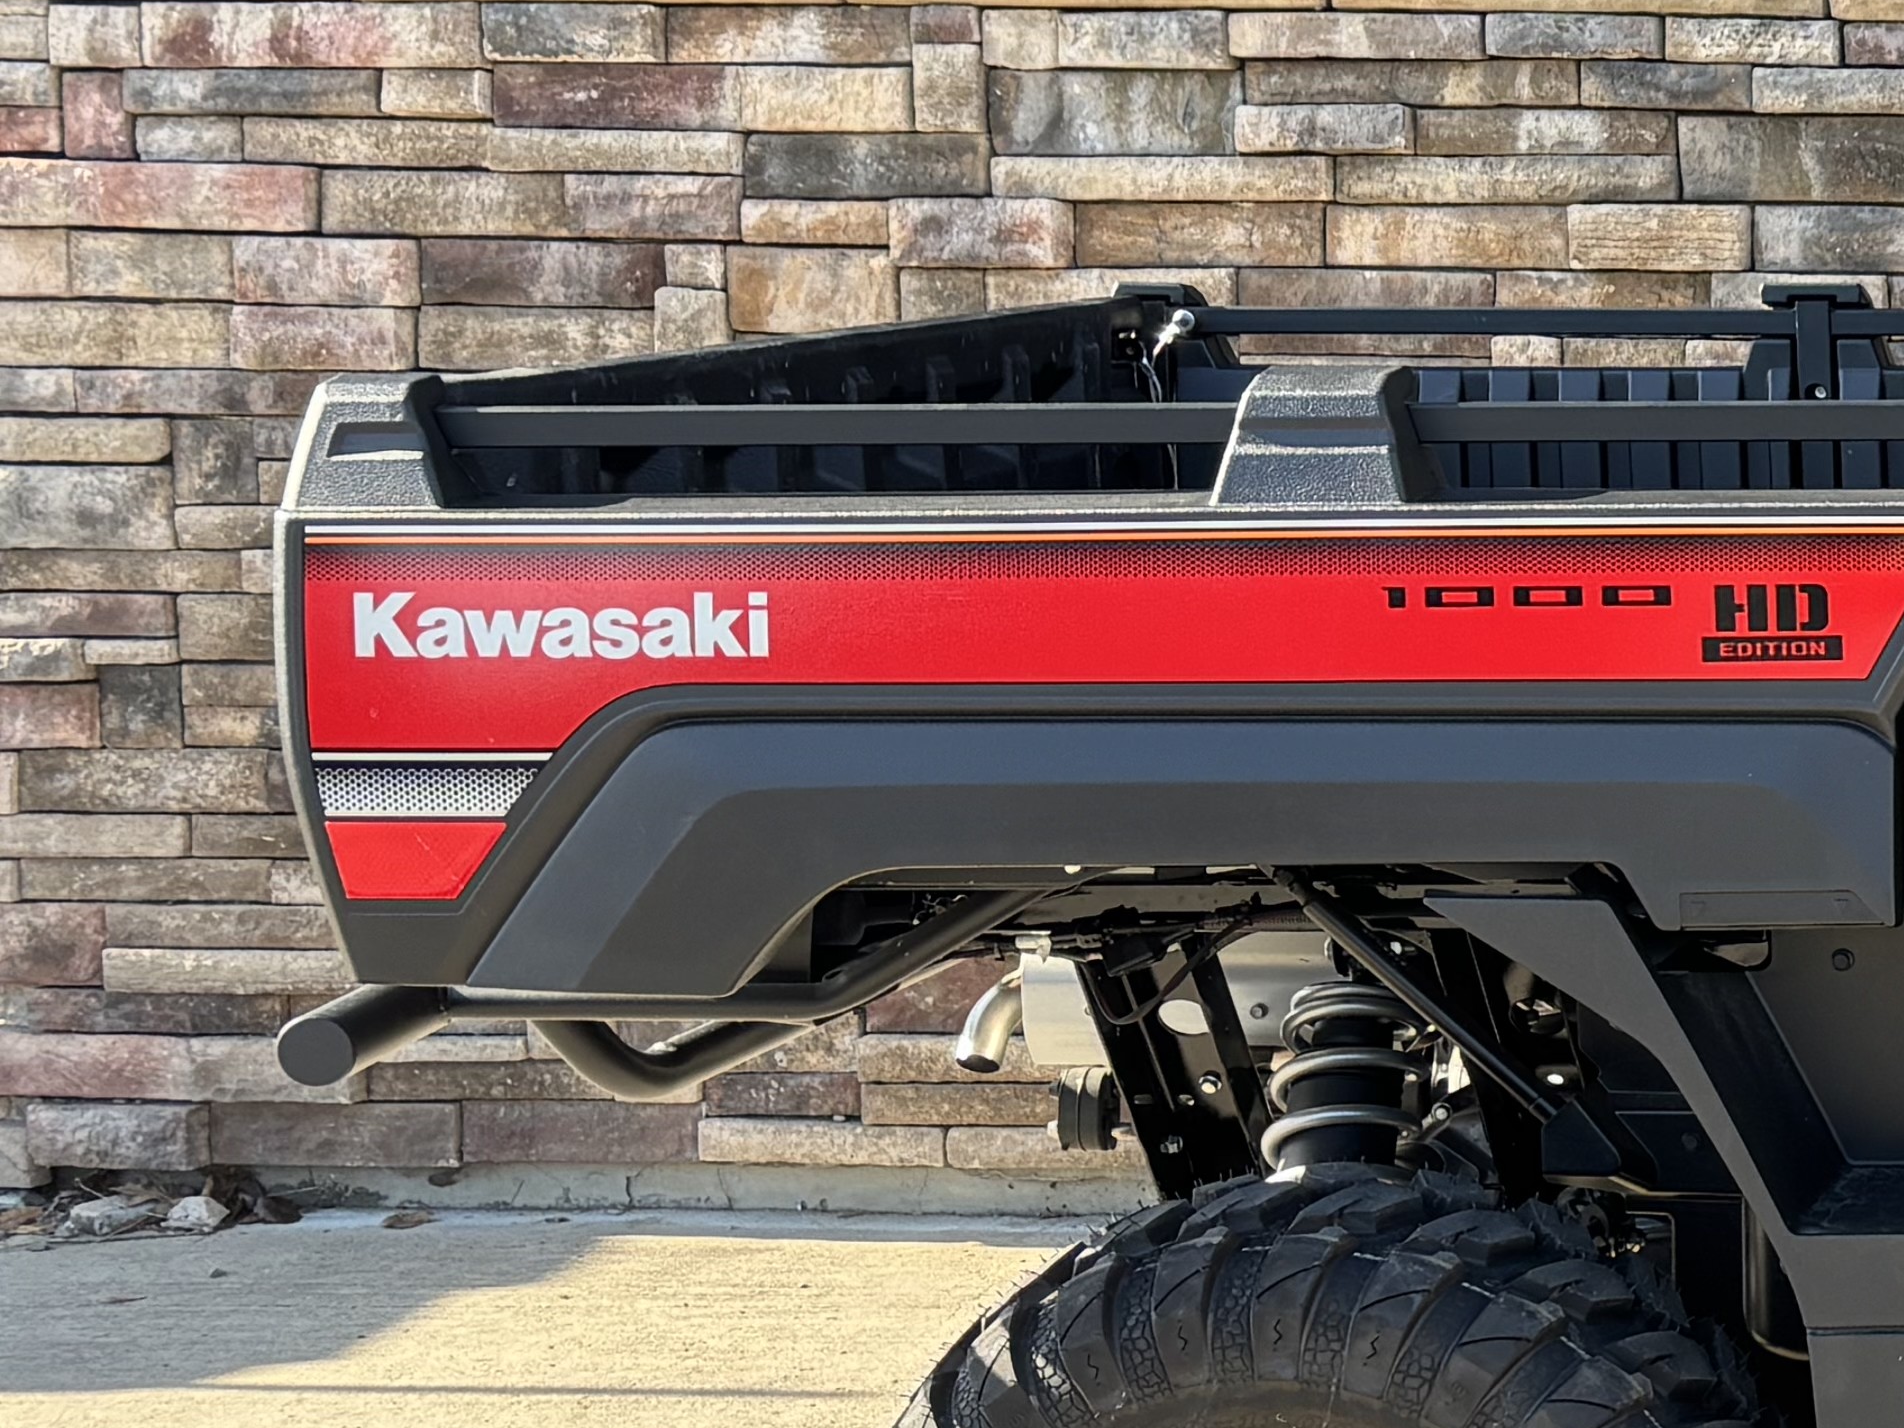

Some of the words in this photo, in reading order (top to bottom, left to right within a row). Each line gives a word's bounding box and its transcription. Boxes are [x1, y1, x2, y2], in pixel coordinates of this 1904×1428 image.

[352, 591, 770, 660] Kawasaki
[1381, 585, 1672, 609] 1000
[1713, 583, 1829, 633] HD
[1718, 641, 1827, 658] EDITION
